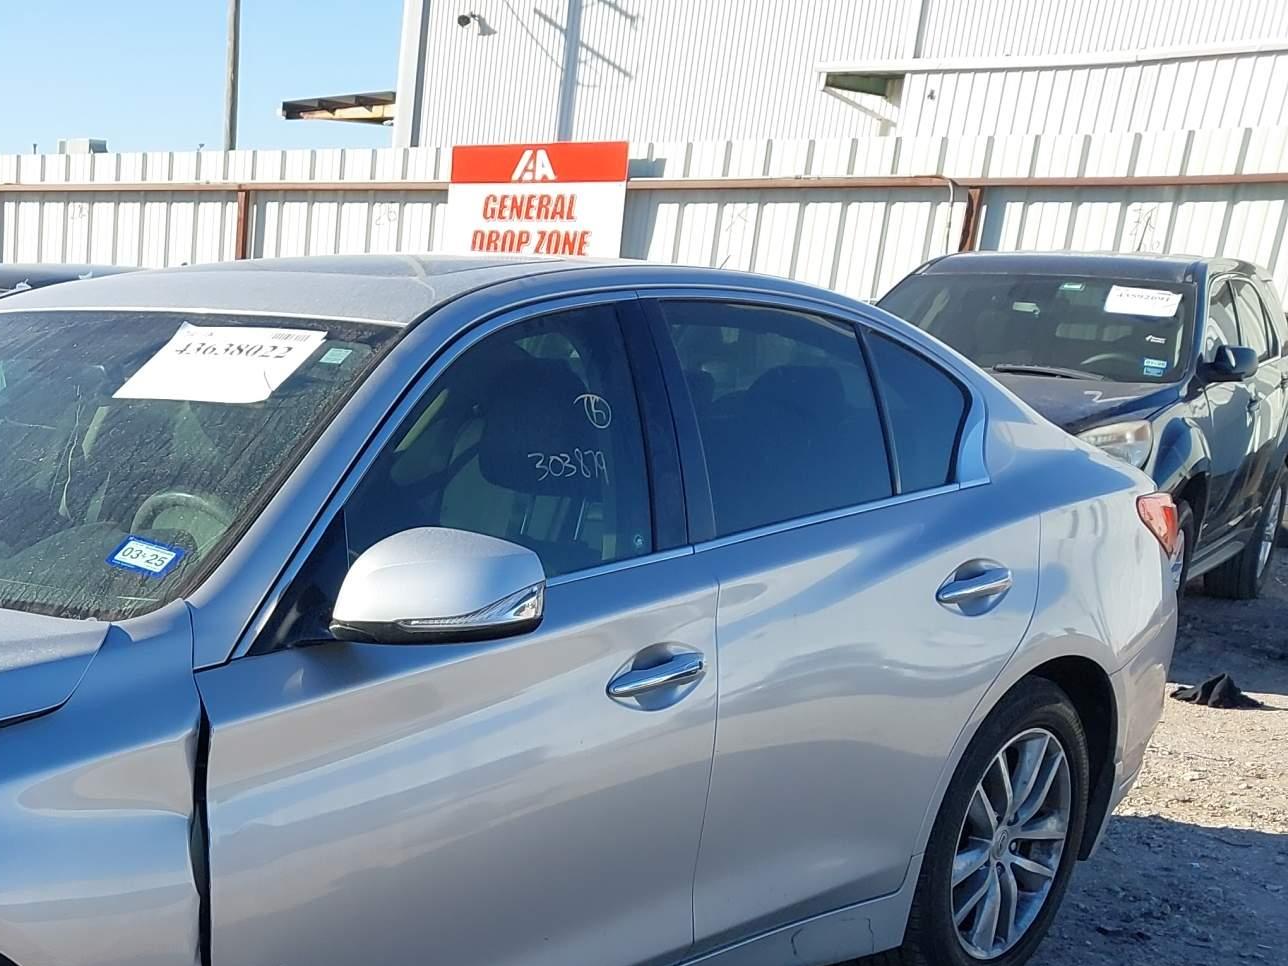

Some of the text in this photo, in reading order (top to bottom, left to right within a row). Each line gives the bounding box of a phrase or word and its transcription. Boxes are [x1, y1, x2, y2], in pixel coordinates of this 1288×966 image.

[482, 193, 578, 221] GENERAL
[470, 229, 592, 256] DROP ZONE
[175, 341, 294, 359] 43638022
[121, 547, 169, 567] 03 25
